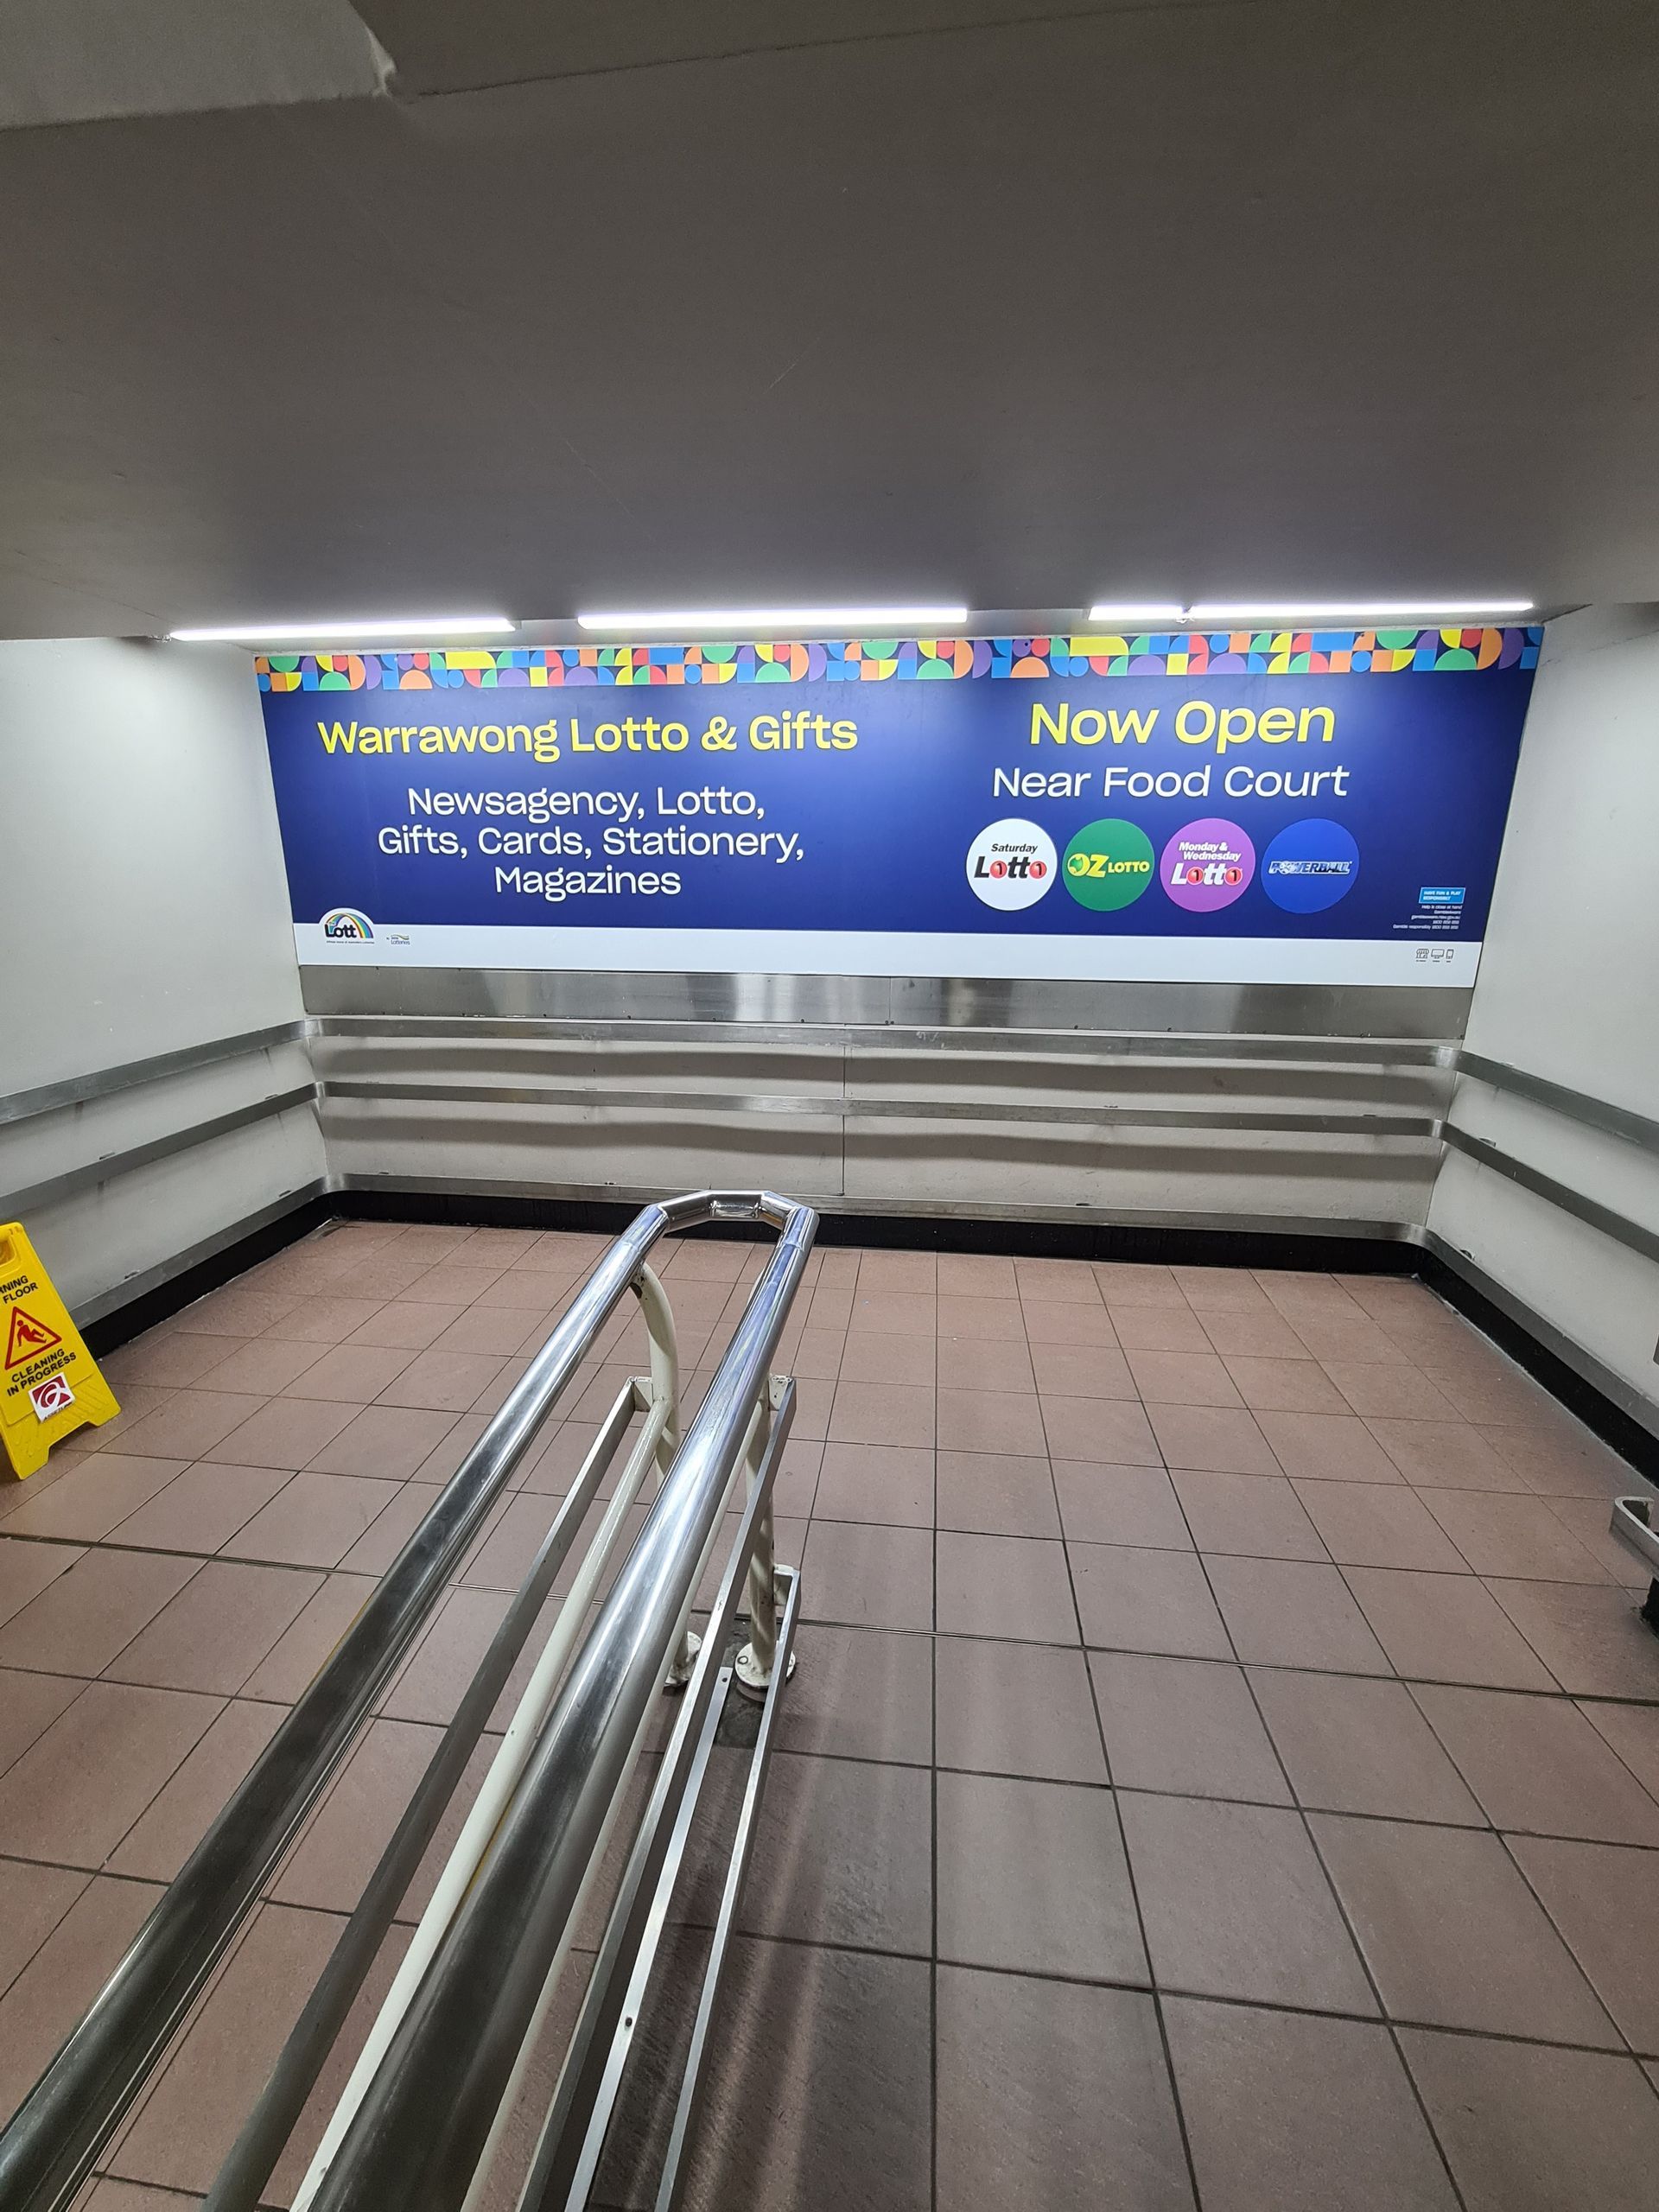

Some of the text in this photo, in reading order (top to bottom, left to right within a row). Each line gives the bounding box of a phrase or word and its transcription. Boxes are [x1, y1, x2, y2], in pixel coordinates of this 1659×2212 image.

[318, 711, 858, 762] Warrawong Lotto & Gifts
[1030, 700, 1336, 753] Now Open
[993, 765, 1350, 798] Near Food Court
[408, 786, 765, 823] Newsagency, Lotto,
[378, 825, 804, 863] Gifts, Cards, Stationery,
[990, 843, 1039, 855] Saturday
[1178, 842, 1228, 853] Monday &
[1183, 850, 1242, 861] Wednesday
[974, 855, 1047, 880] Lotto
[1067, 853, 1150, 878] OZ LOTTO
[1171, 863, 1243, 886] Lotto
[495, 865, 681, 901] Magazines
[324, 924, 358, 938] Lott
[3, 1282, 38, 1304] FLOOR
[7, 1352, 77, 1397] IN PROGRESS
[11, 1348, 65, 1382] CLEANING
